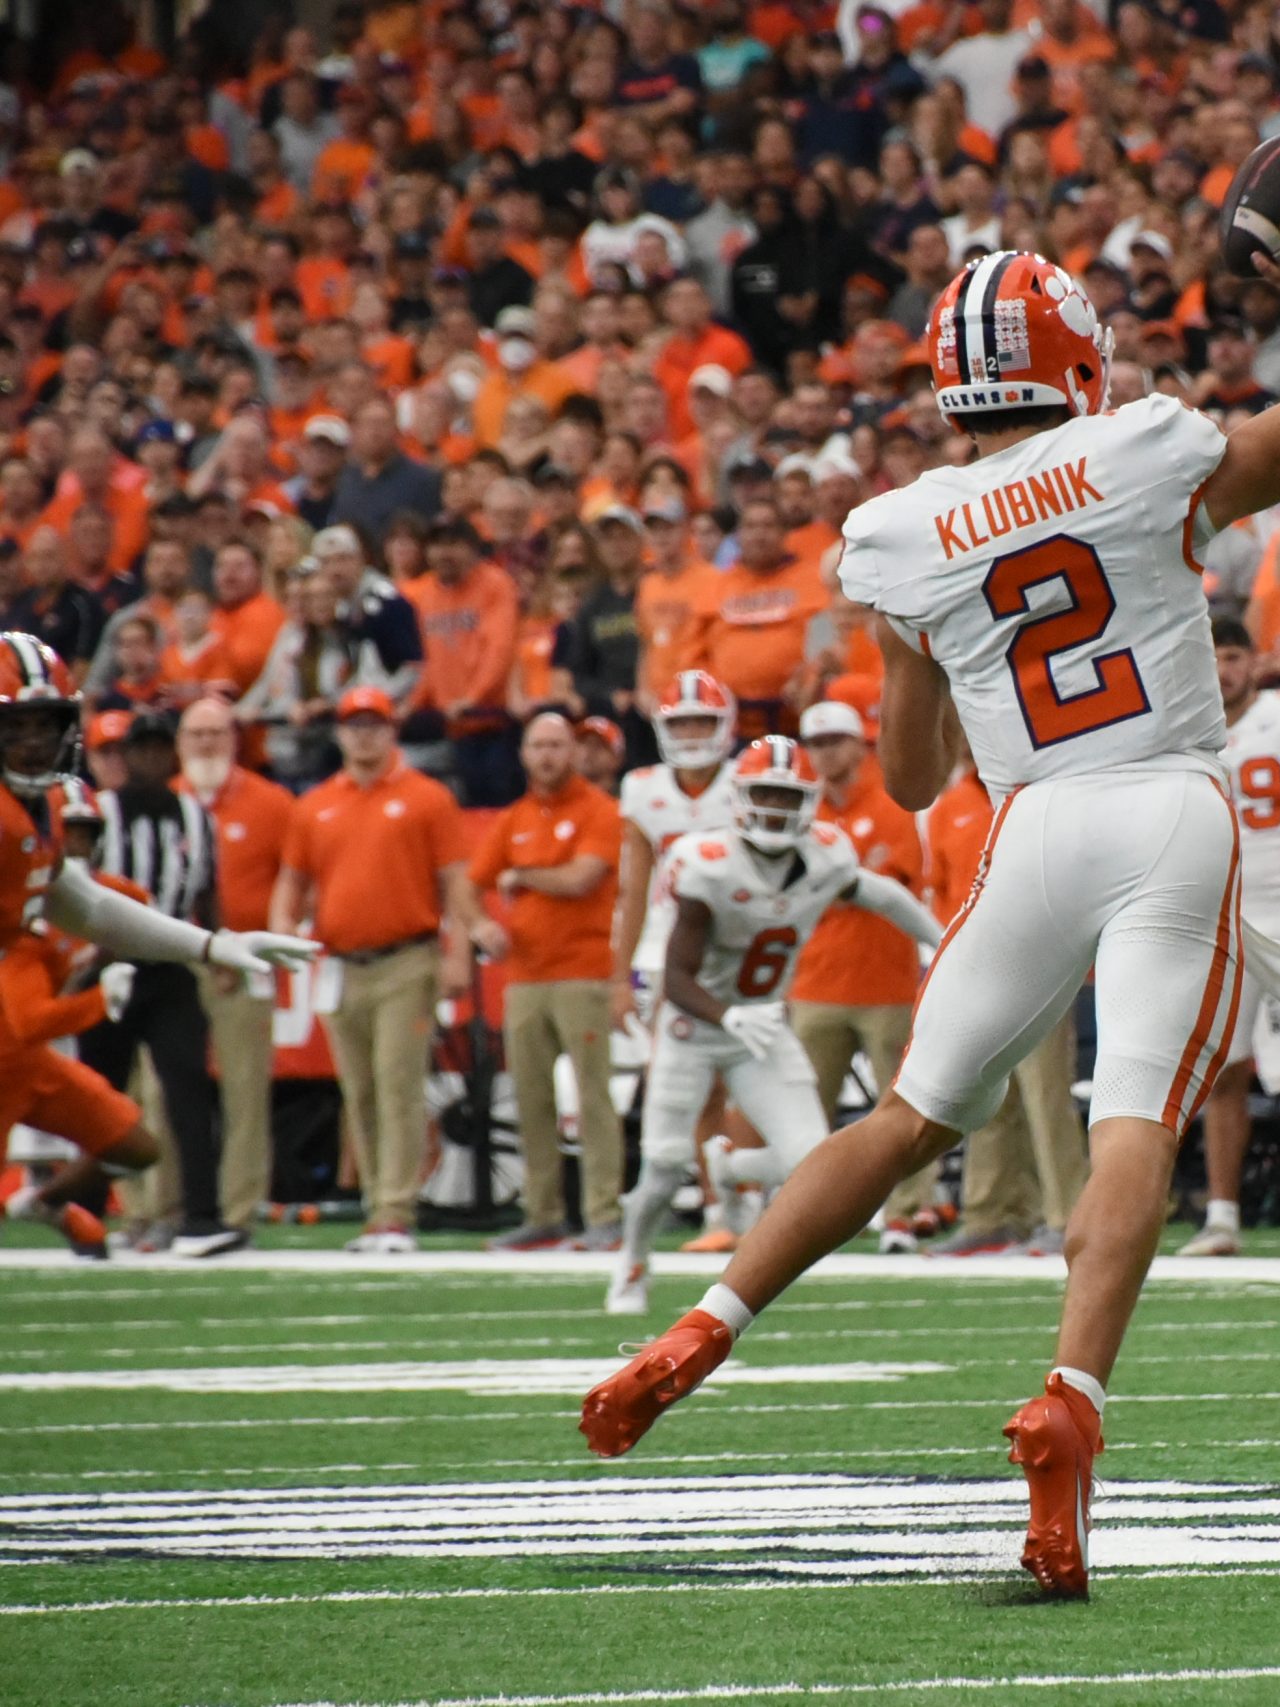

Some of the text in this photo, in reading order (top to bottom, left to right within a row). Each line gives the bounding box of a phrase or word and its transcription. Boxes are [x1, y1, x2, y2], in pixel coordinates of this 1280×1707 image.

[941, 388, 1034, 408] CLEMSN
[986, 356, 998, 371] 2
[934, 456, 1105, 560] KLUBNIK
[981, 532, 1152, 751] 2
[737, 926, 797, 998] 6
